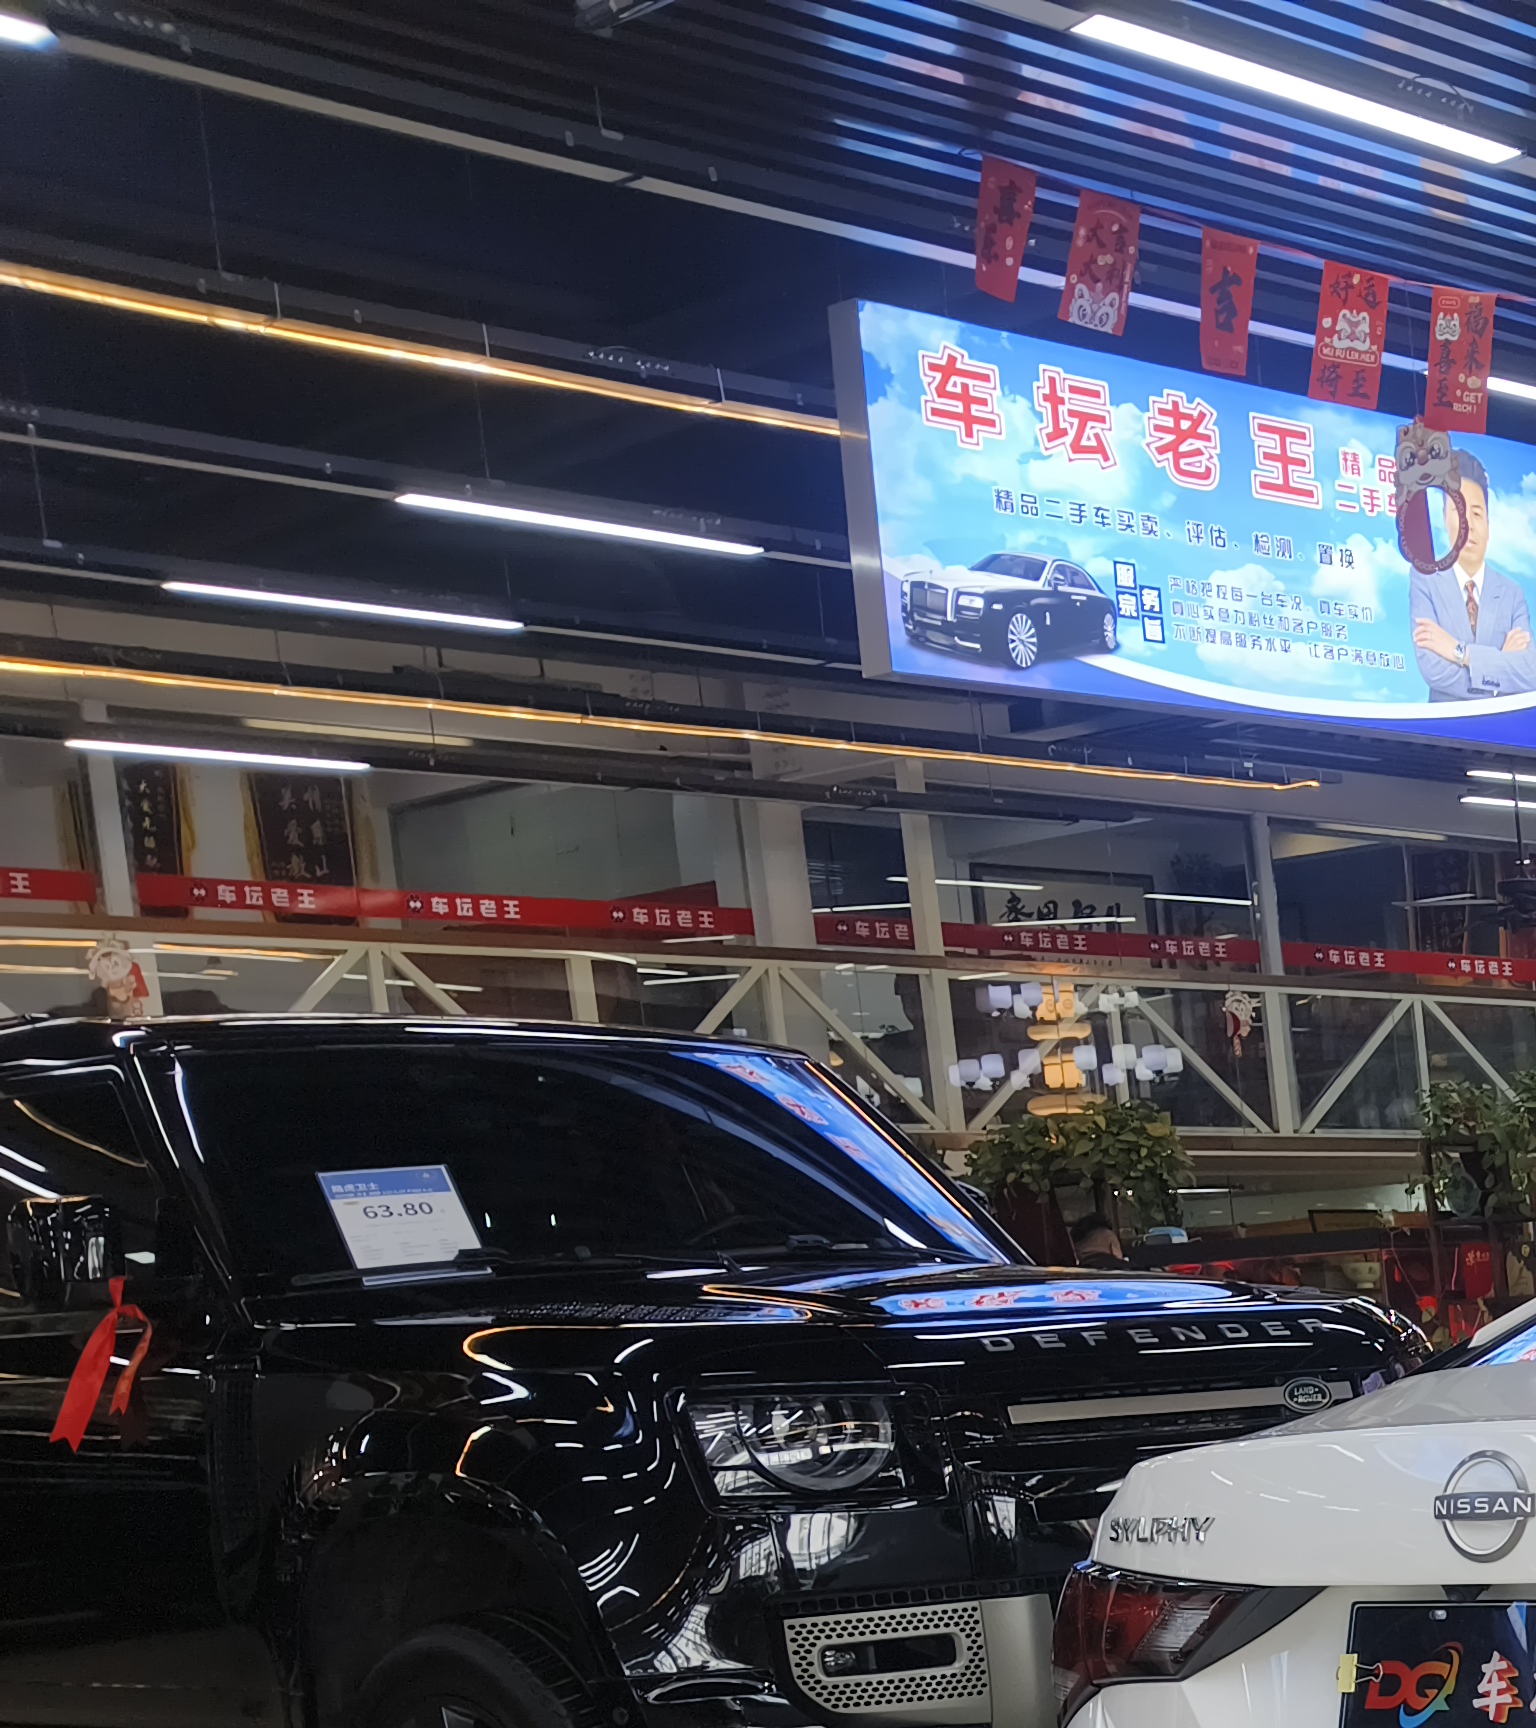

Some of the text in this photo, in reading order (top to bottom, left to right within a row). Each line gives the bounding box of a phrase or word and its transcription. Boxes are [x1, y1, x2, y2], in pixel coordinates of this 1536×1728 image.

[1463, 392, 1483, 403] GET
[918, 344, 1323, 509] 车坛老王
[1339, 447, 1398, 485] 精品
[10, 872, 31, 895] 王
[216, 883, 317, 910] 车坛老王
[431, 895, 521, 920] 车坛老王
[632, 906, 715, 930] 车坛老王
[1019, 931, 1088, 953] 车坛老王
[1164, 938, 1228, 959] 车坛老王
[1328, 948, 1387, 969] 车坛老王
[362, 1201, 434, 1219] 63.80
[984, 1317, 1330, 1352] DEFENDER
[1294, 1385, 1315, 1396] LAND
[1434, 1496, 1533, 1516] NISSAN
[1109, 1515, 1215, 1544] SYLPHY
